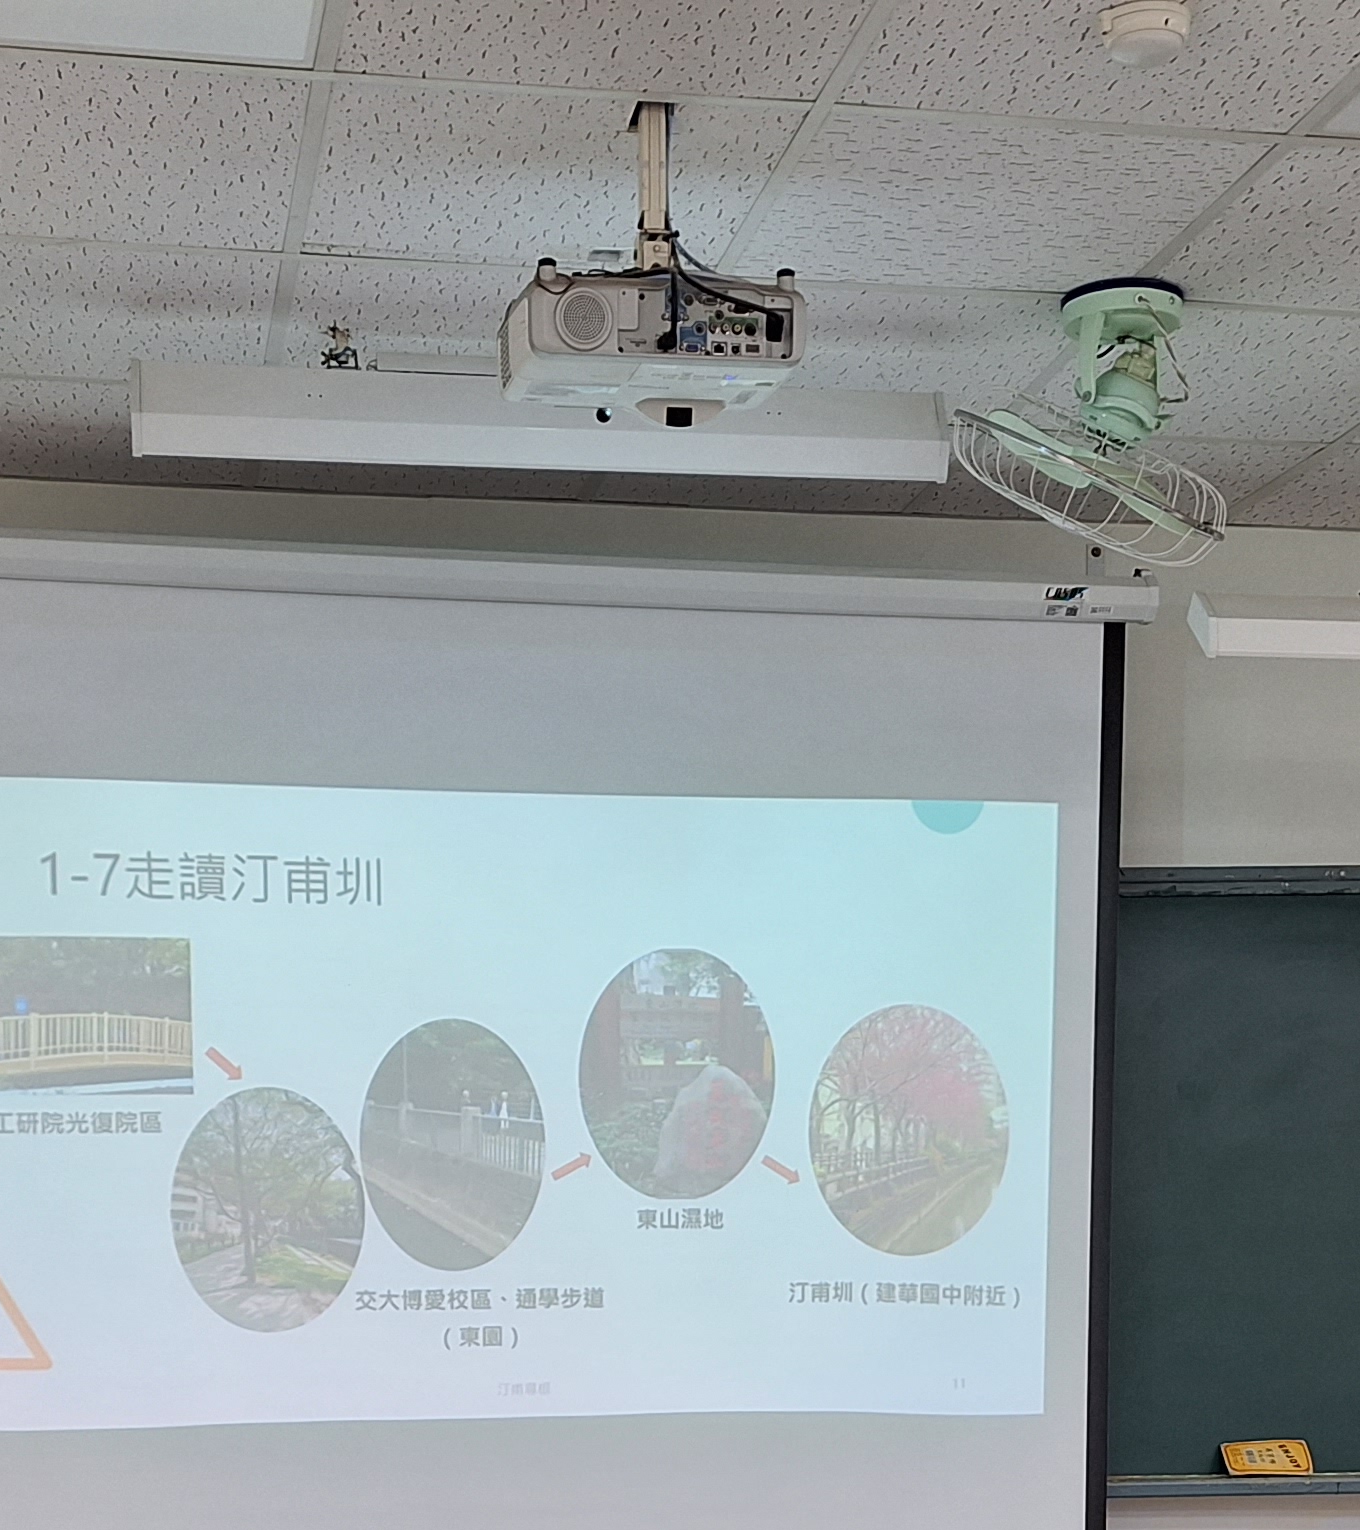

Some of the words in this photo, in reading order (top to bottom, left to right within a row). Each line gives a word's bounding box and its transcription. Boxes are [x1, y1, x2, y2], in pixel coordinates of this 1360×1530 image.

[40, 851, 382, 906] 1-7走讀汀甫圳
[637, 1208, 724, 1230] 東山濕地
[355, 1286, 605, 1311] 交大博愛校區、通學步道
